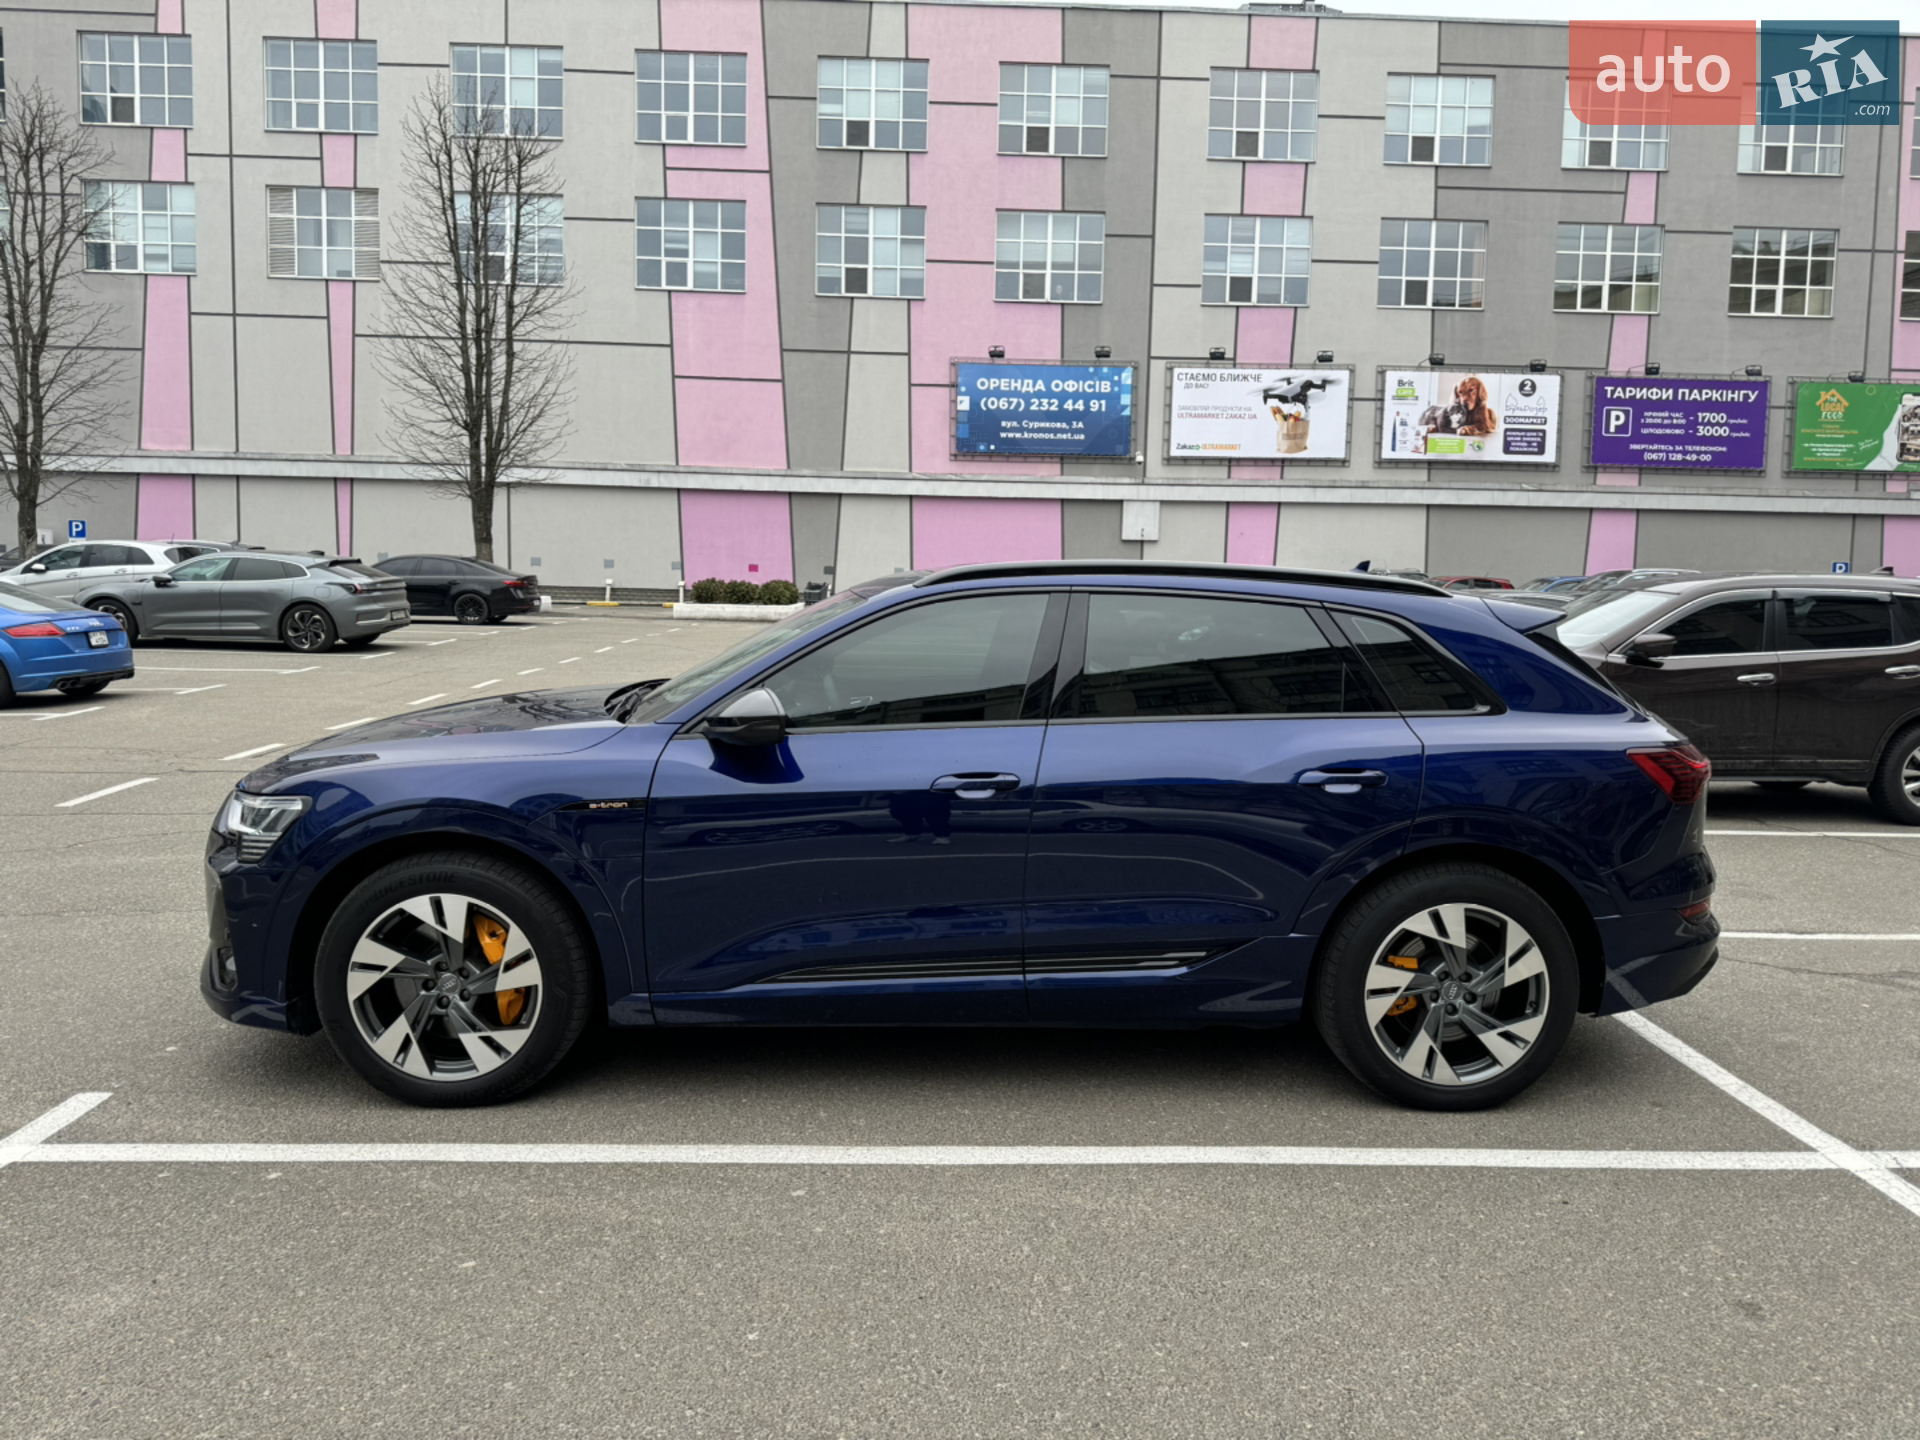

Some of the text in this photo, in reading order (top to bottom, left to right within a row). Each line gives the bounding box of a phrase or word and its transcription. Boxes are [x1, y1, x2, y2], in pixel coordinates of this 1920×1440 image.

[1177, 372, 1263, 383] СТАЄМО БЛИЖЧЕ
[976, 378, 1112, 393] ОРЕНДА ОФІСІВ
[1397, 379, 1414, 387] Brit
[1523, 380, 1532, 391] 2
[1604, 386, 1759, 403] ТАРИФИ ПАРКІНГУ
[980, 397, 1106, 412] (067) 232 44 91
[1821, 403, 1845, 413] LOCAL
[1609, 410, 1626, 433] P
[1697, 413, 1727, 423] 1700
[1022, 420, 1070, 430] Сурикова,
[1000, 431, 1085, 440] www.kronos.net.ua
[1641, 427, 1685, 435] ЦІЛОДОБОВО
[1696, 426, 1729, 437] 3000
[1643, 452, 1712, 462] (067) 128-49-00
[72, 521, 83, 537] P
[589, 801, 628, 809] e-tron
